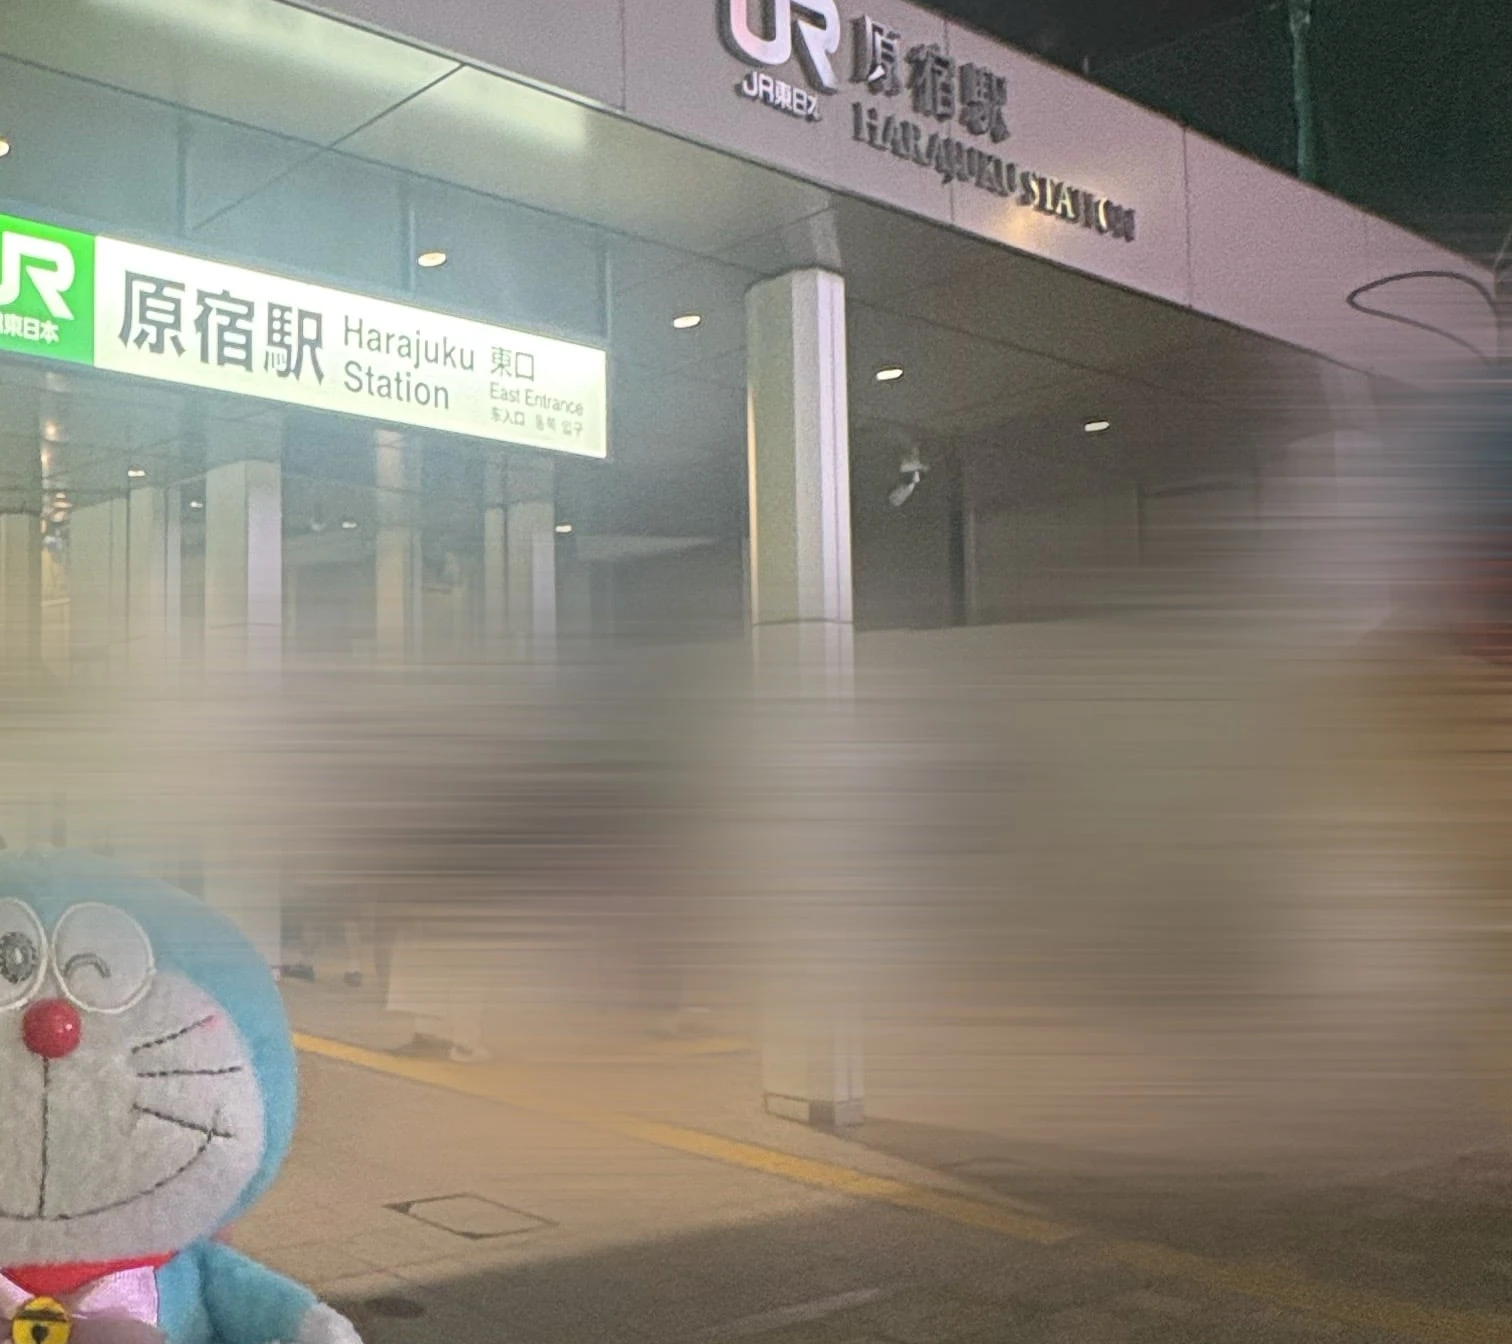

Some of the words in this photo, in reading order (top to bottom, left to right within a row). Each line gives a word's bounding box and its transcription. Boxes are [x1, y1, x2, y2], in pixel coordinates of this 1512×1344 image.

[850, 13, 1011, 142] 原宿駅
[118, 269, 325, 385] 原宿駅
[344, 314, 474, 372] Harajuku
[344, 360, 449, 410] Station
[490, 345, 534, 382] 東口
[490, 381, 520, 404] East
[525, 388, 584, 417] Entrance
